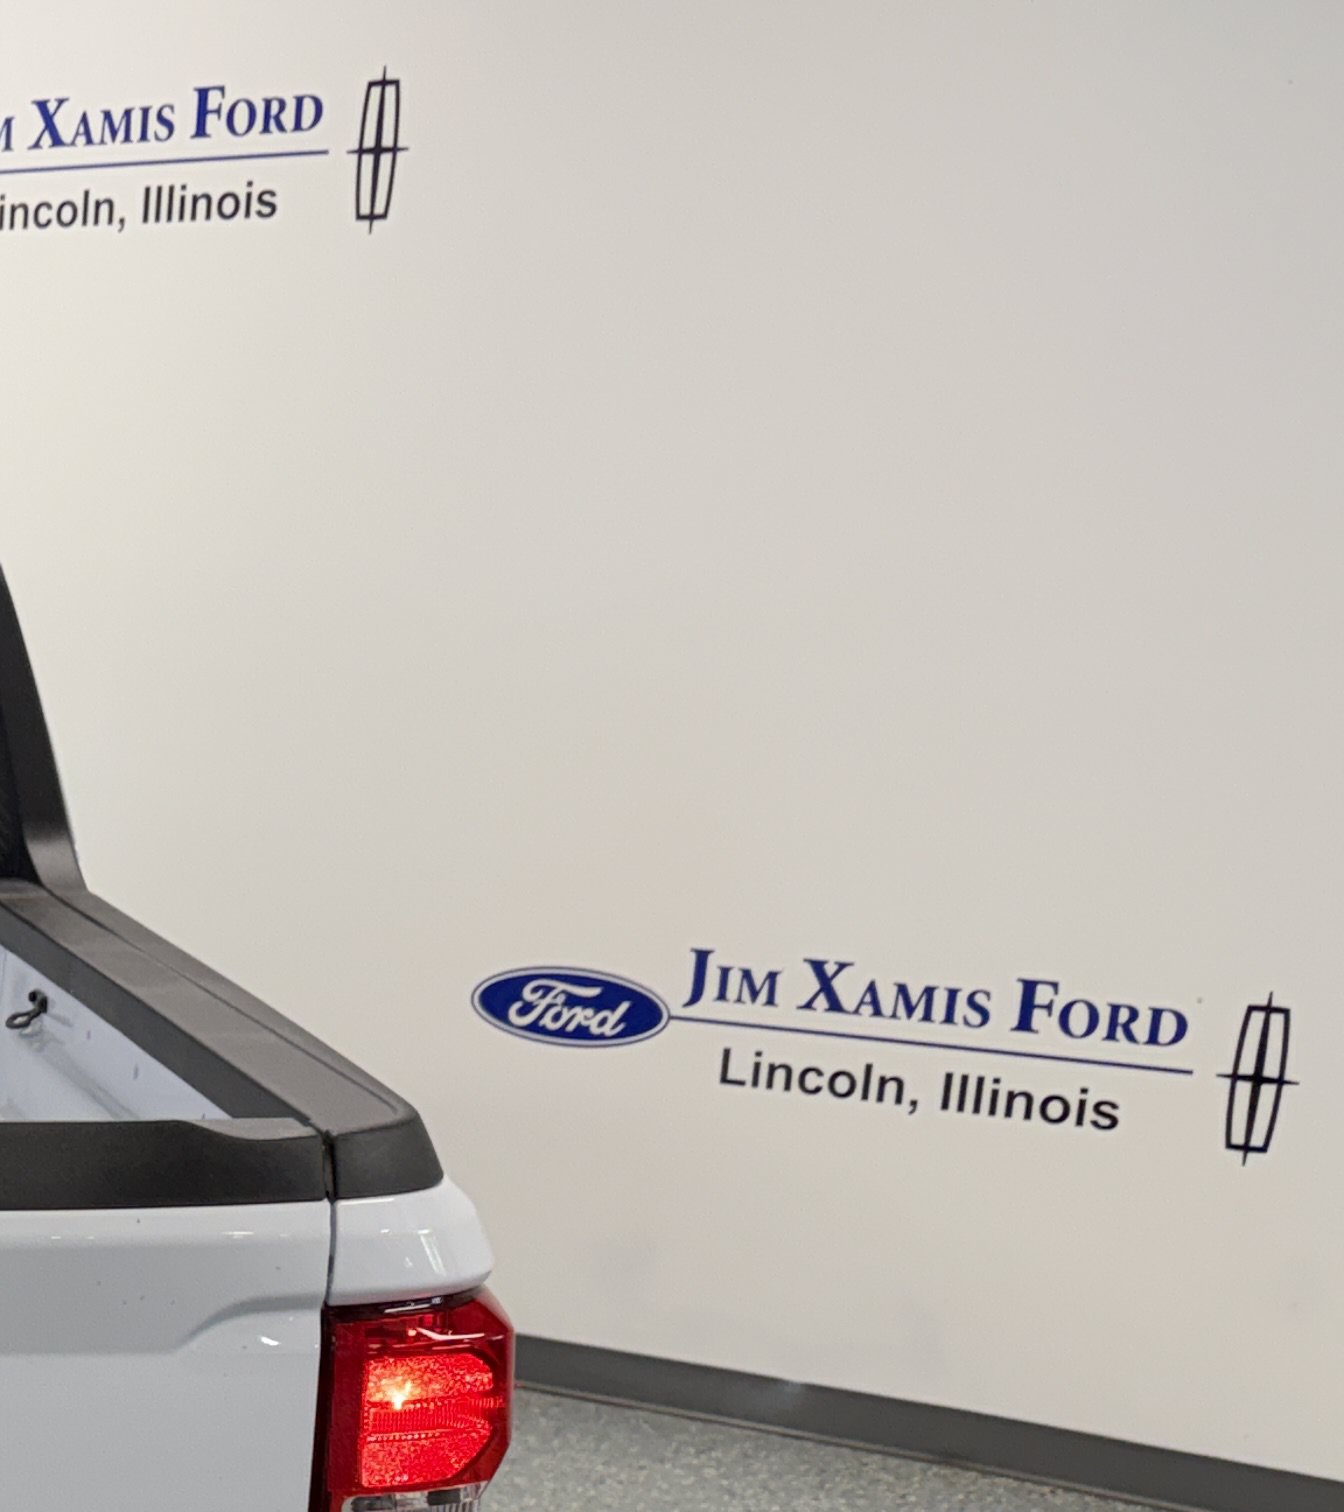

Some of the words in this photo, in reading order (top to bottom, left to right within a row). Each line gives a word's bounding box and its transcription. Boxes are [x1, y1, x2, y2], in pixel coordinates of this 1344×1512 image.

[27, 98, 176, 150] XAMIS
[189, 84, 324, 139] FORD
[141, 181, 278, 223] Illinois
[507, 978, 627, 1038] Ford
[682, 948, 782, 1010] JIM
[796, 959, 993, 1029] XAMIS
[1010, 978, 1189, 1048] FORD
[719, 1047, 920, 1115] Lincoln,
[940, 1073, 1121, 1131] Illinois
